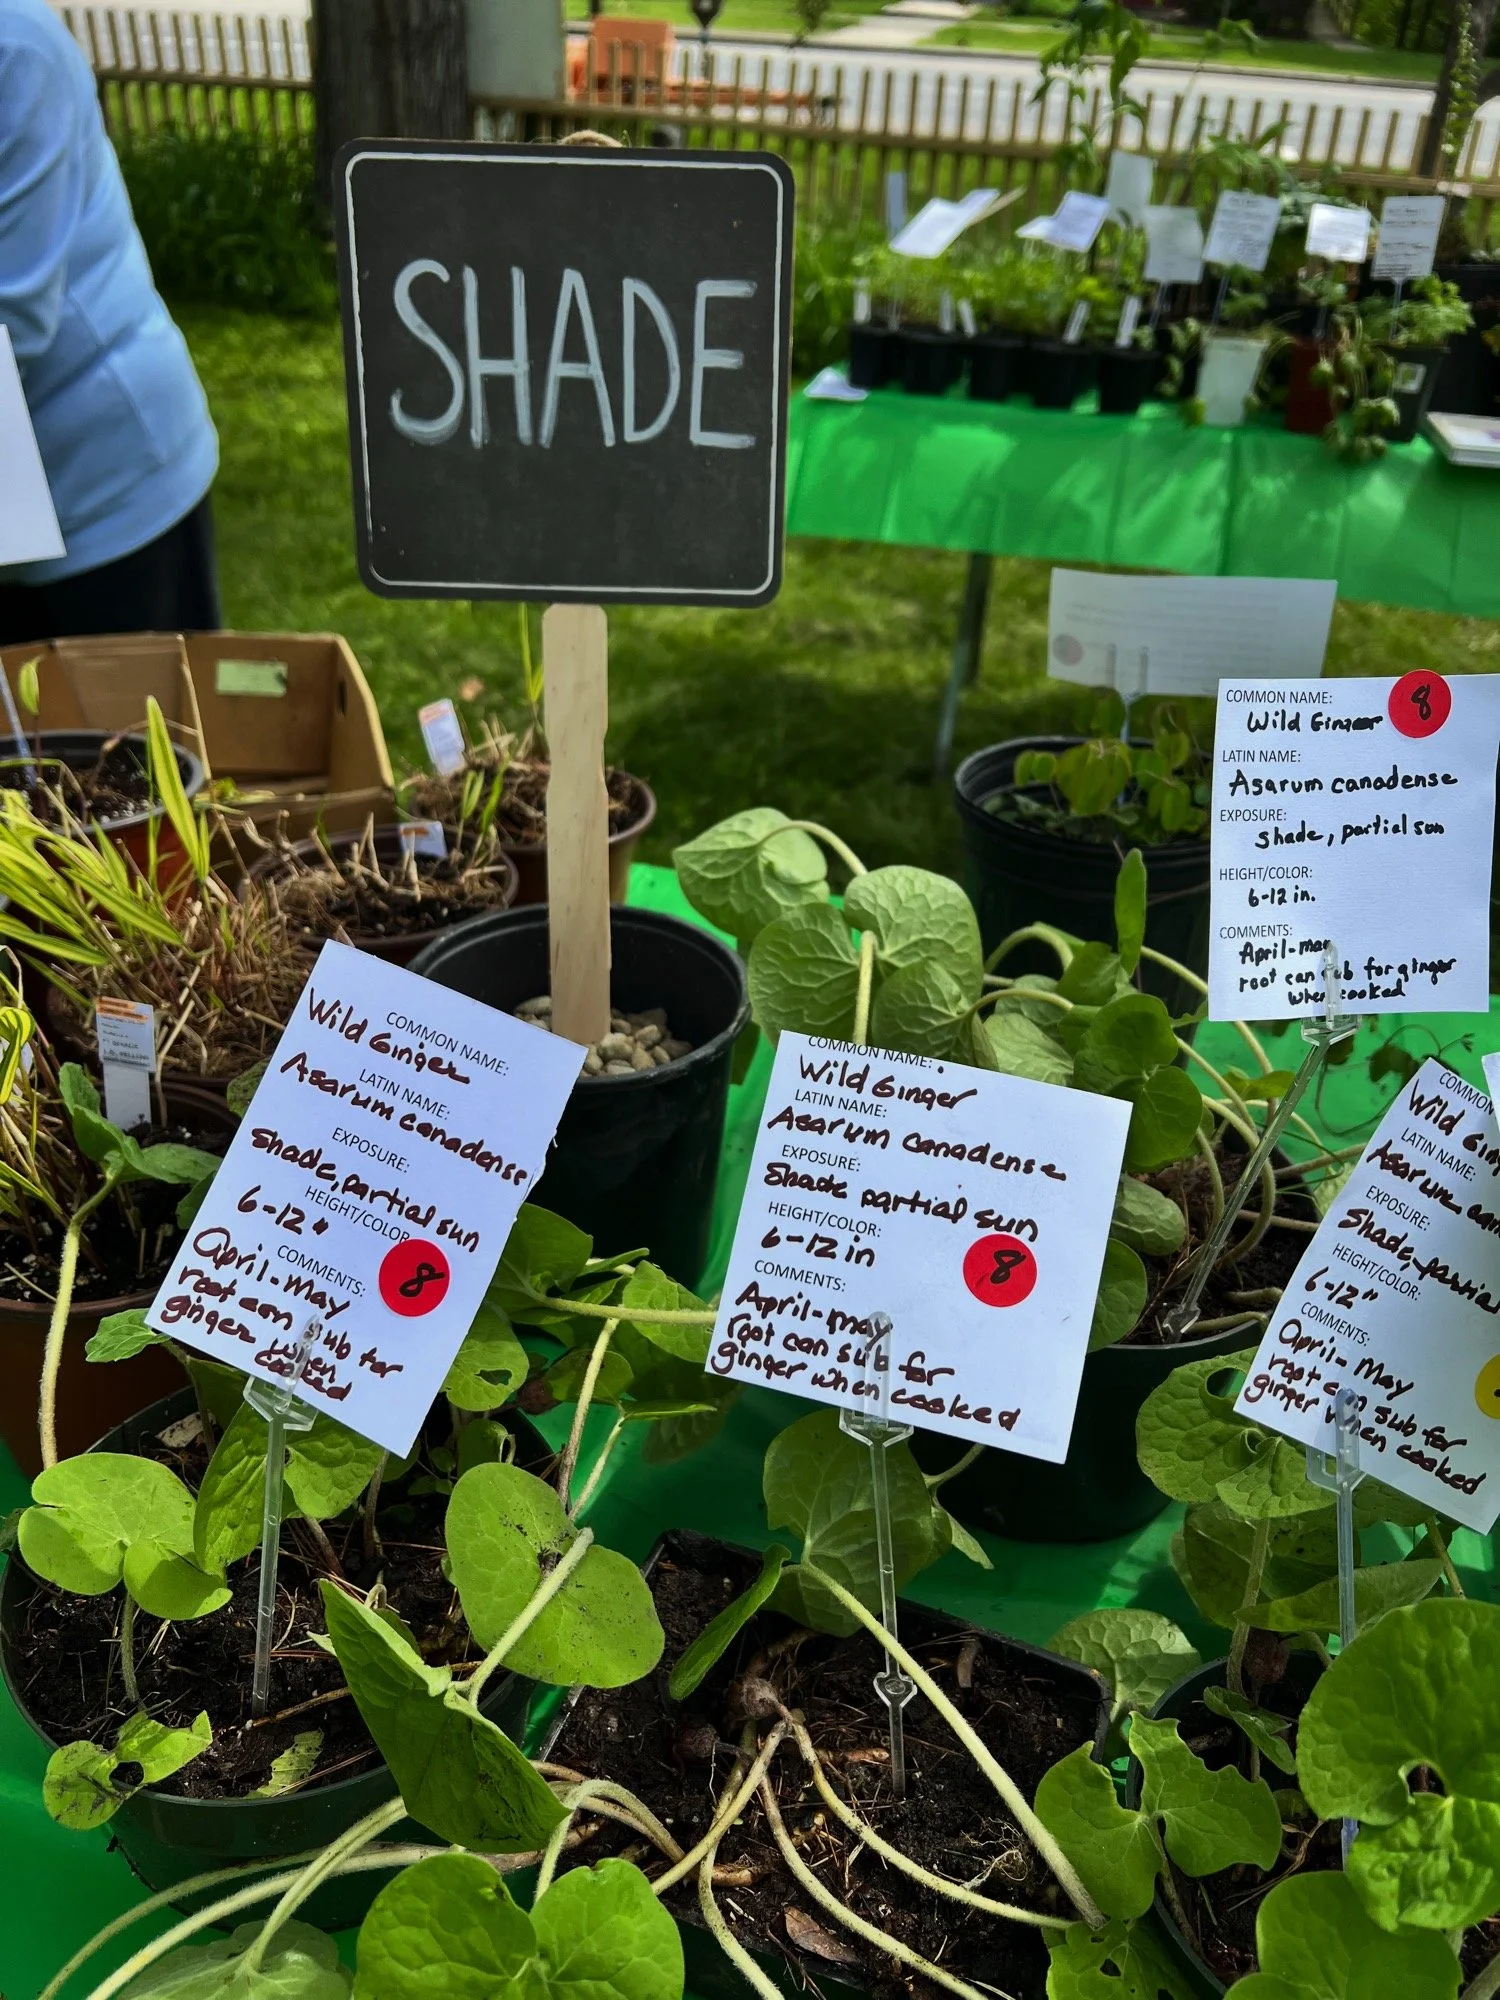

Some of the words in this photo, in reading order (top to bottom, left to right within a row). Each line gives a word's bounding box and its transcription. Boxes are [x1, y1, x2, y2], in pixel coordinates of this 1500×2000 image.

[389, 257, 758, 451] SHADE
[1226, 689, 1286, 704] COMMON
[1289, 691, 1333, 704] NAME:
[1410, 684, 1431, 720] 8
[1247, 709, 1300, 733] Wild
[1222, 750, 1255, 763] LATIN
[1259, 750, 1301, 763] NAME:
[1229, 768, 1323, 797] Asarum
[1220, 808, 1287, 822] EXPOSURE:
[1341, 813, 1407, 845] partial
[1219, 866, 1313, 882] HEIGHT/COLOR:
[1248, 887, 1287, 907] 6-12
[1219, 924, 1293, 939] COMMENTS:
[1240, 968, 1277, 992] root
[1285, 970, 1315, 985] can
[1321, 960, 1354, 981] ub
[1364, 956, 1394, 980] for
[308, 987, 368, 1043] Wild
[369, 1032, 470, 1084] Ginger
[387, 1011, 458, 1053] COMMON
[459, 1044, 509, 1077] NAME:
[808, 1035, 879, 1058] COMMON
[280, 1052, 394, 1121] Asarum
[359, 1068, 400, 1097] LATIN
[401, 1088, 450, 1120] NAME:
[800, 1053, 870, 1094] Wild
[871, 1075, 978, 1111] Ginger
[795, 1089, 833, 1108] LATIN
[838, 1096, 887, 1118] NAME:
[1409, 1078, 1465, 1136] Wild
[767, 1105, 890, 1149] Asarum
[331, 1127, 410, 1174] EXPOSURE:
[782, 1144, 861, 1172] EXPOSURE:
[1401, 1127, 1436, 1157] LATIN
[1435, 1148, 1476, 1182] NAME:
[768, 1201, 882, 1238] HEIGHT/COLOR:
[861, 1190, 967, 1224] partial
[973, 1209, 1038, 1242] sun
[1365, 1185, 1431, 1232] EXPOSURE:
[436, 1219, 479, 1253] sun
[761, 1226, 838, 1259] 6-12
[844, 1235, 876, 1267] in
[178, 1266, 237, 1302] root
[277, 1244, 366, 1297] COMMENTS:
[399, 1262, 446, 1298] 8
[754, 1259, 847, 1292] COMMENTS:
[990, 1249, 1026, 1284] 8
[1332, 1242, 1421, 1301] HEIGHT/COLOR:
[1300, 1301, 1370, 1347] COMMENTS:
[728, 1313, 775, 1348] root
[782, 1333, 829, 1356] can
[837, 1342, 890, 1372] sub
[899, 1351, 955, 1386] for
[710, 1341, 808, 1380] ginger
[811, 1368, 880, 1400] when
[891, 1388, 1021, 1431] cooked
[1268, 1352, 1321, 1387] root
[1374, 1405, 1417, 1437] sub
[1422, 1425, 1467, 1452] for
[1243, 1373, 1320, 1412] ginger
[1396, 1444, 1487, 1495] cooked
